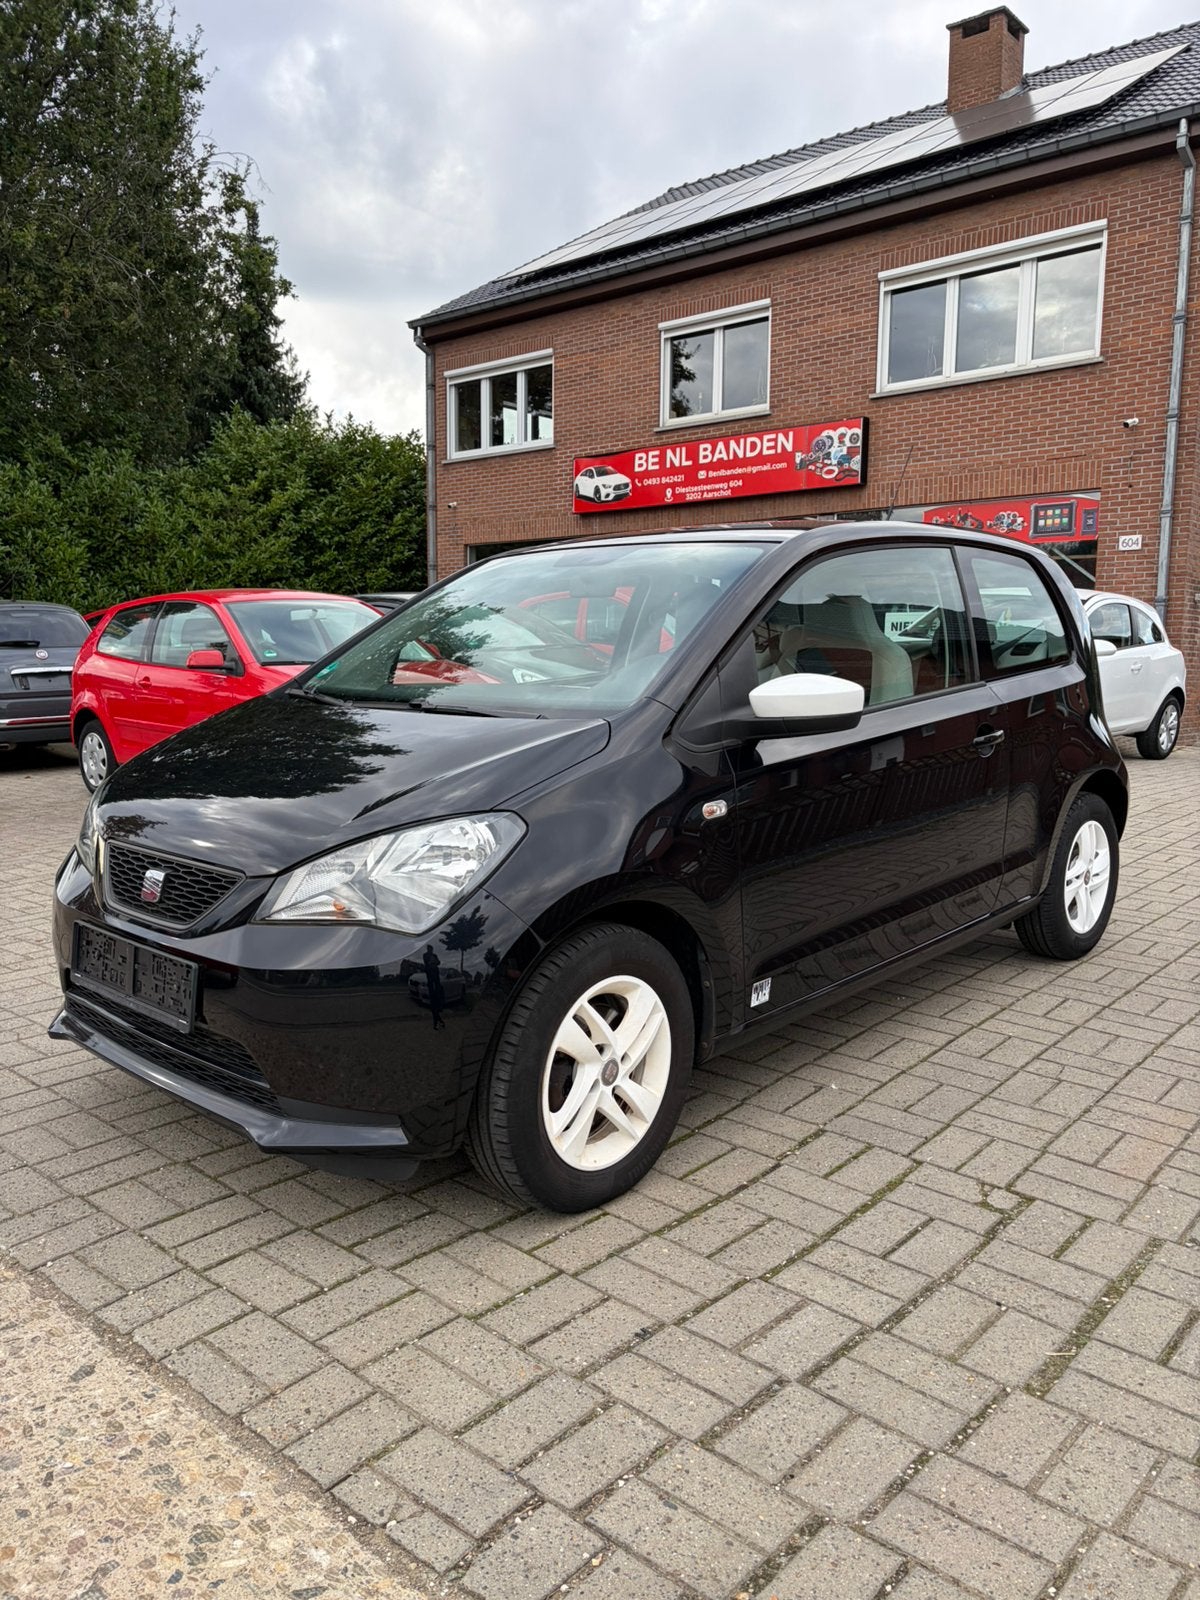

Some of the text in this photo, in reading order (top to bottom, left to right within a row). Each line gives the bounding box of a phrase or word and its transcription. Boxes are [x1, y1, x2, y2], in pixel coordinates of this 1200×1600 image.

[634, 431, 794, 472] BE NL BANDEN
[708, 462, 788, 478] Benlbanden@gmail.com
[643, 474, 685, 486] 0493 842421
[675, 479, 743, 494] Diestsesteenweg 604
[685, 489, 732, 500] 3202 Aarschot
[1121, 537, 1140, 548] 604
